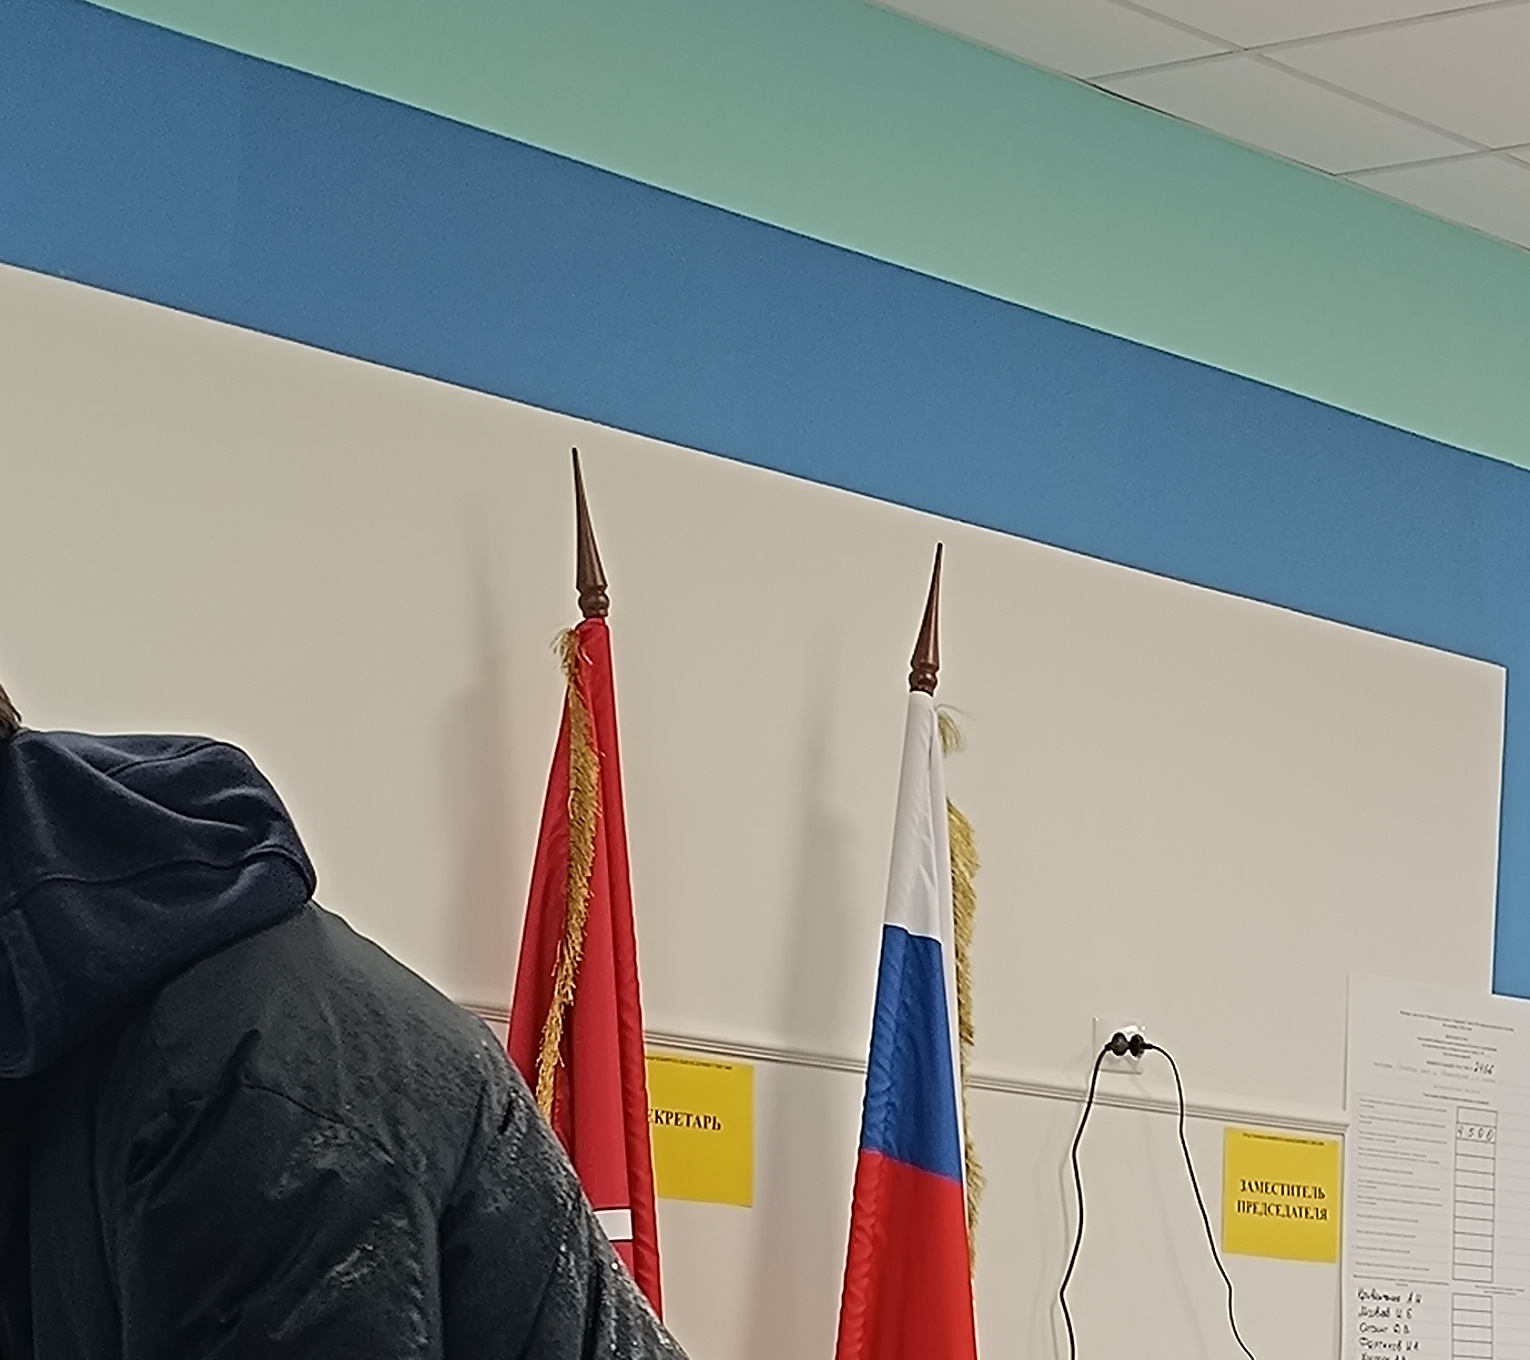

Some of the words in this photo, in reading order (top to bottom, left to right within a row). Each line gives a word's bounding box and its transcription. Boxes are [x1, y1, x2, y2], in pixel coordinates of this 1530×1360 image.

[648, 1108, 721, 1131] КРЕТАРЬ
[1240, 1178, 1326, 1200] ЗАМЕСТИТЕЛЬ
[1236, 1199, 1328, 1221] ПРЕДСЕДАТЕЛЯ
